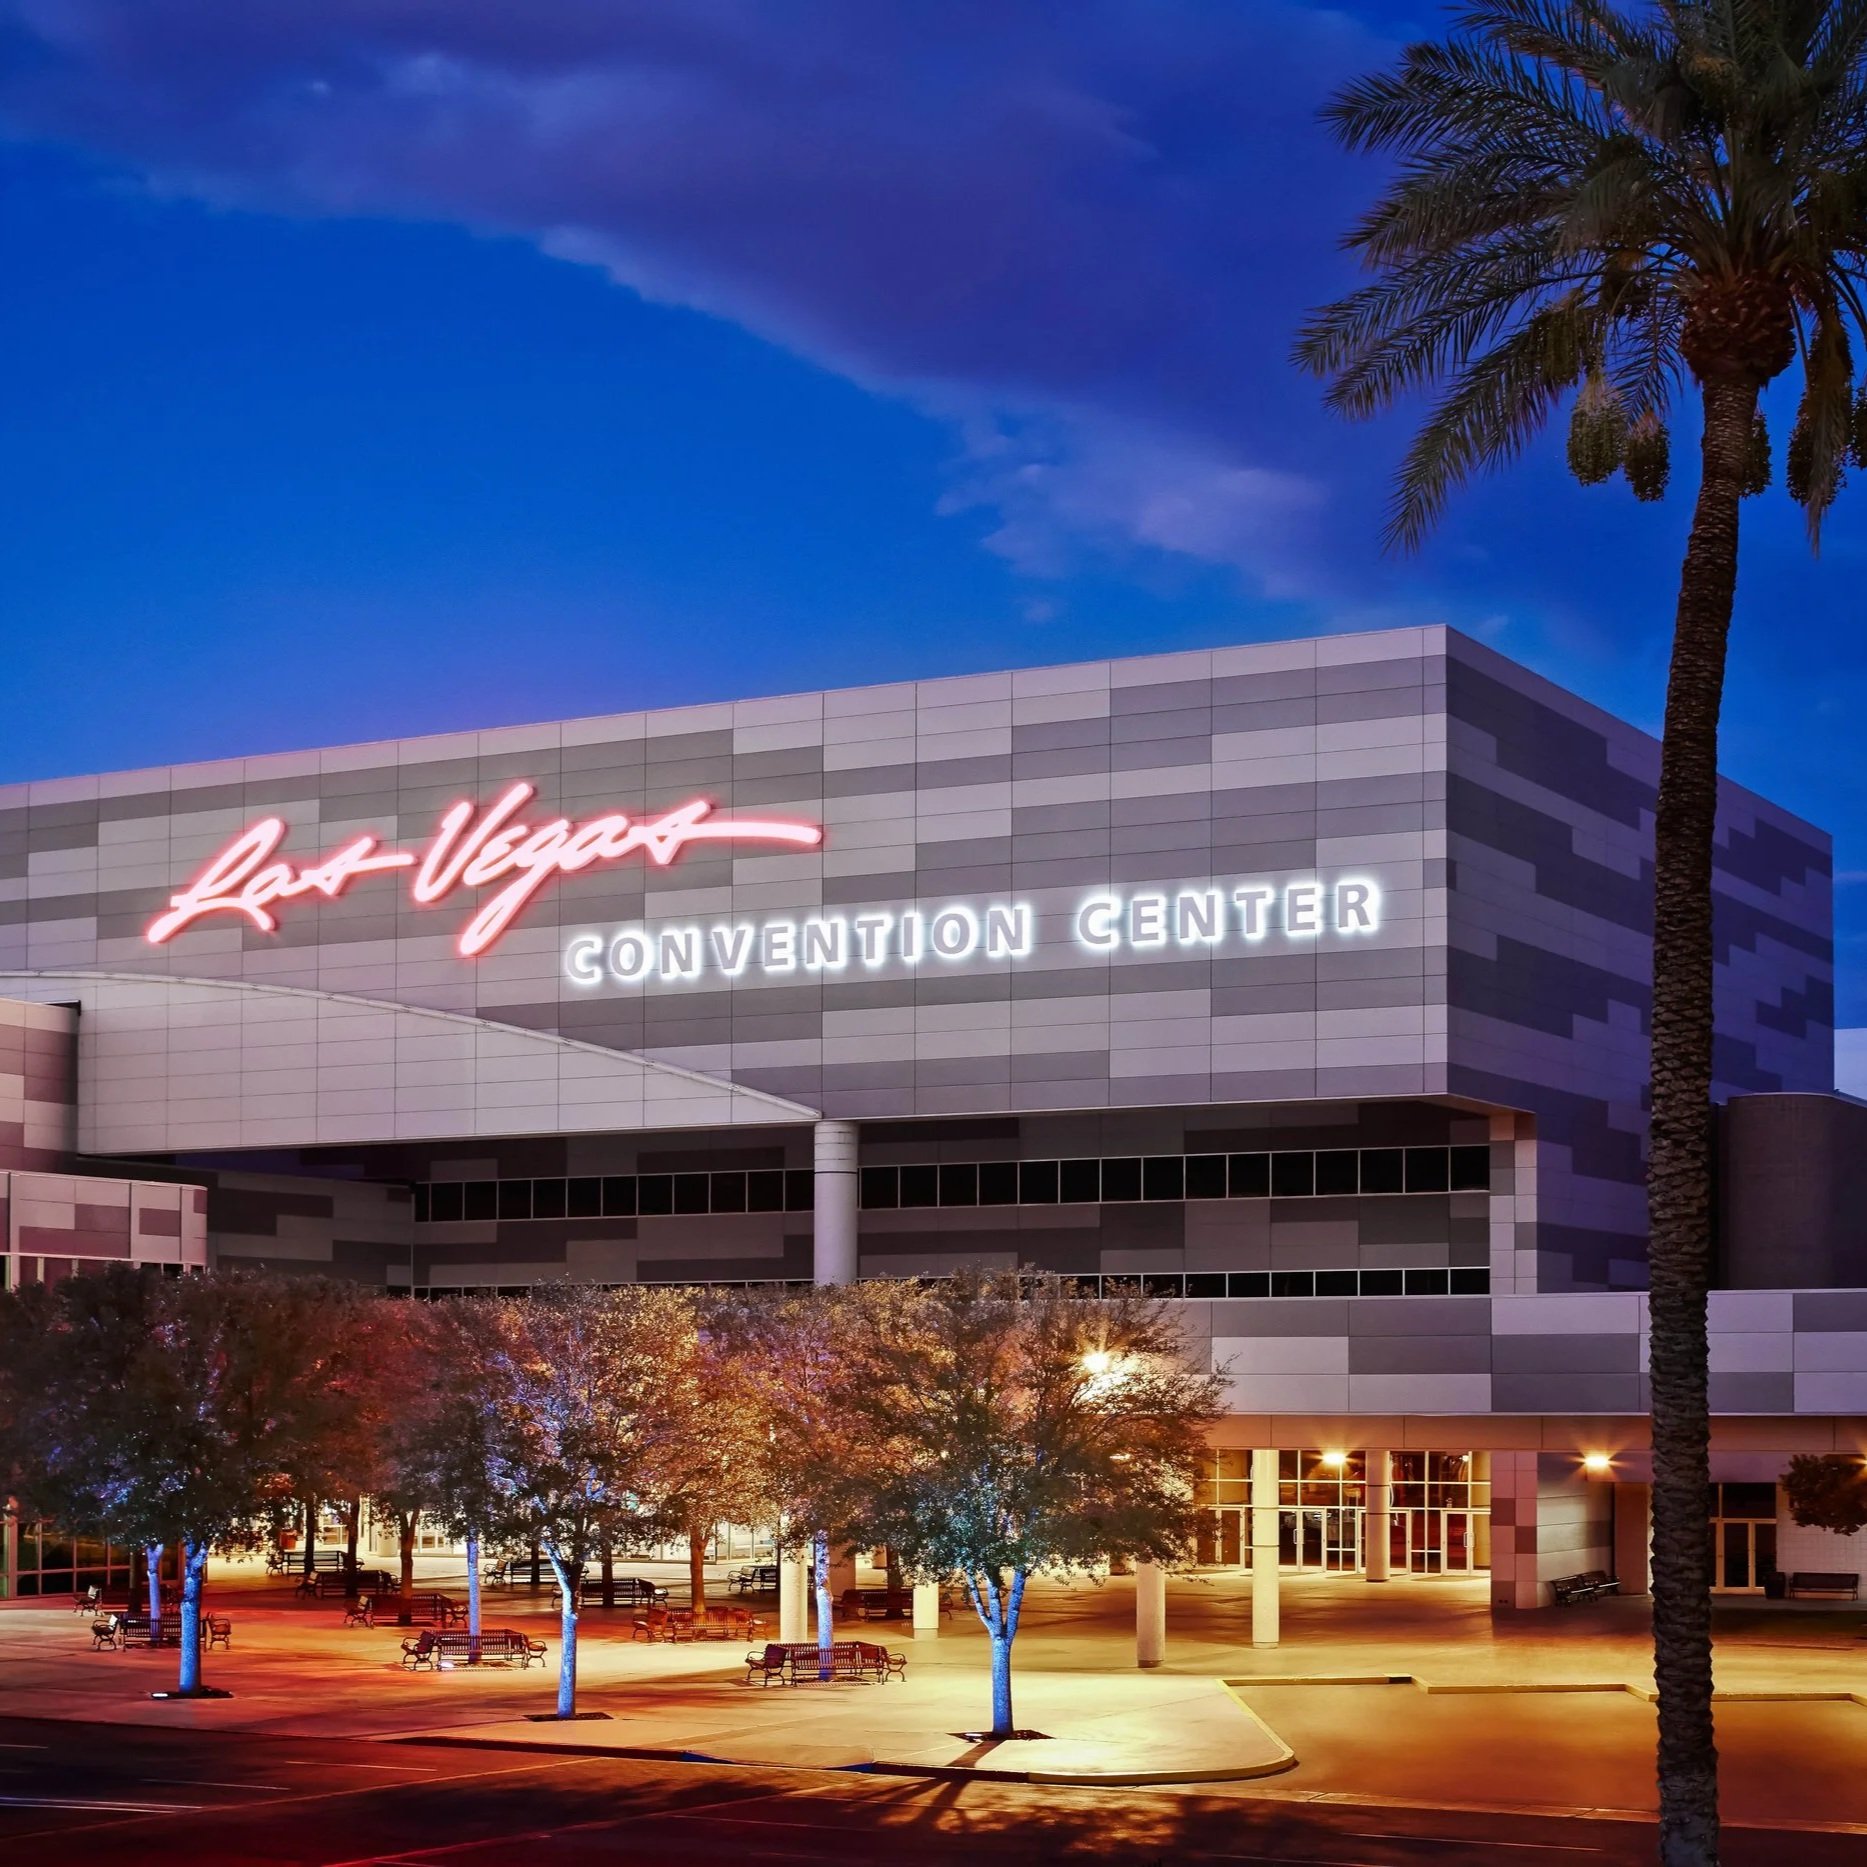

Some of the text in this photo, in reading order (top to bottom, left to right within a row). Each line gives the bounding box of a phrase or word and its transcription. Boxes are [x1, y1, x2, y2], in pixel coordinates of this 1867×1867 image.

[147, 783, 822, 955] Las Vegas
[565, 882, 1373, 981] CONVENTION CENTER
